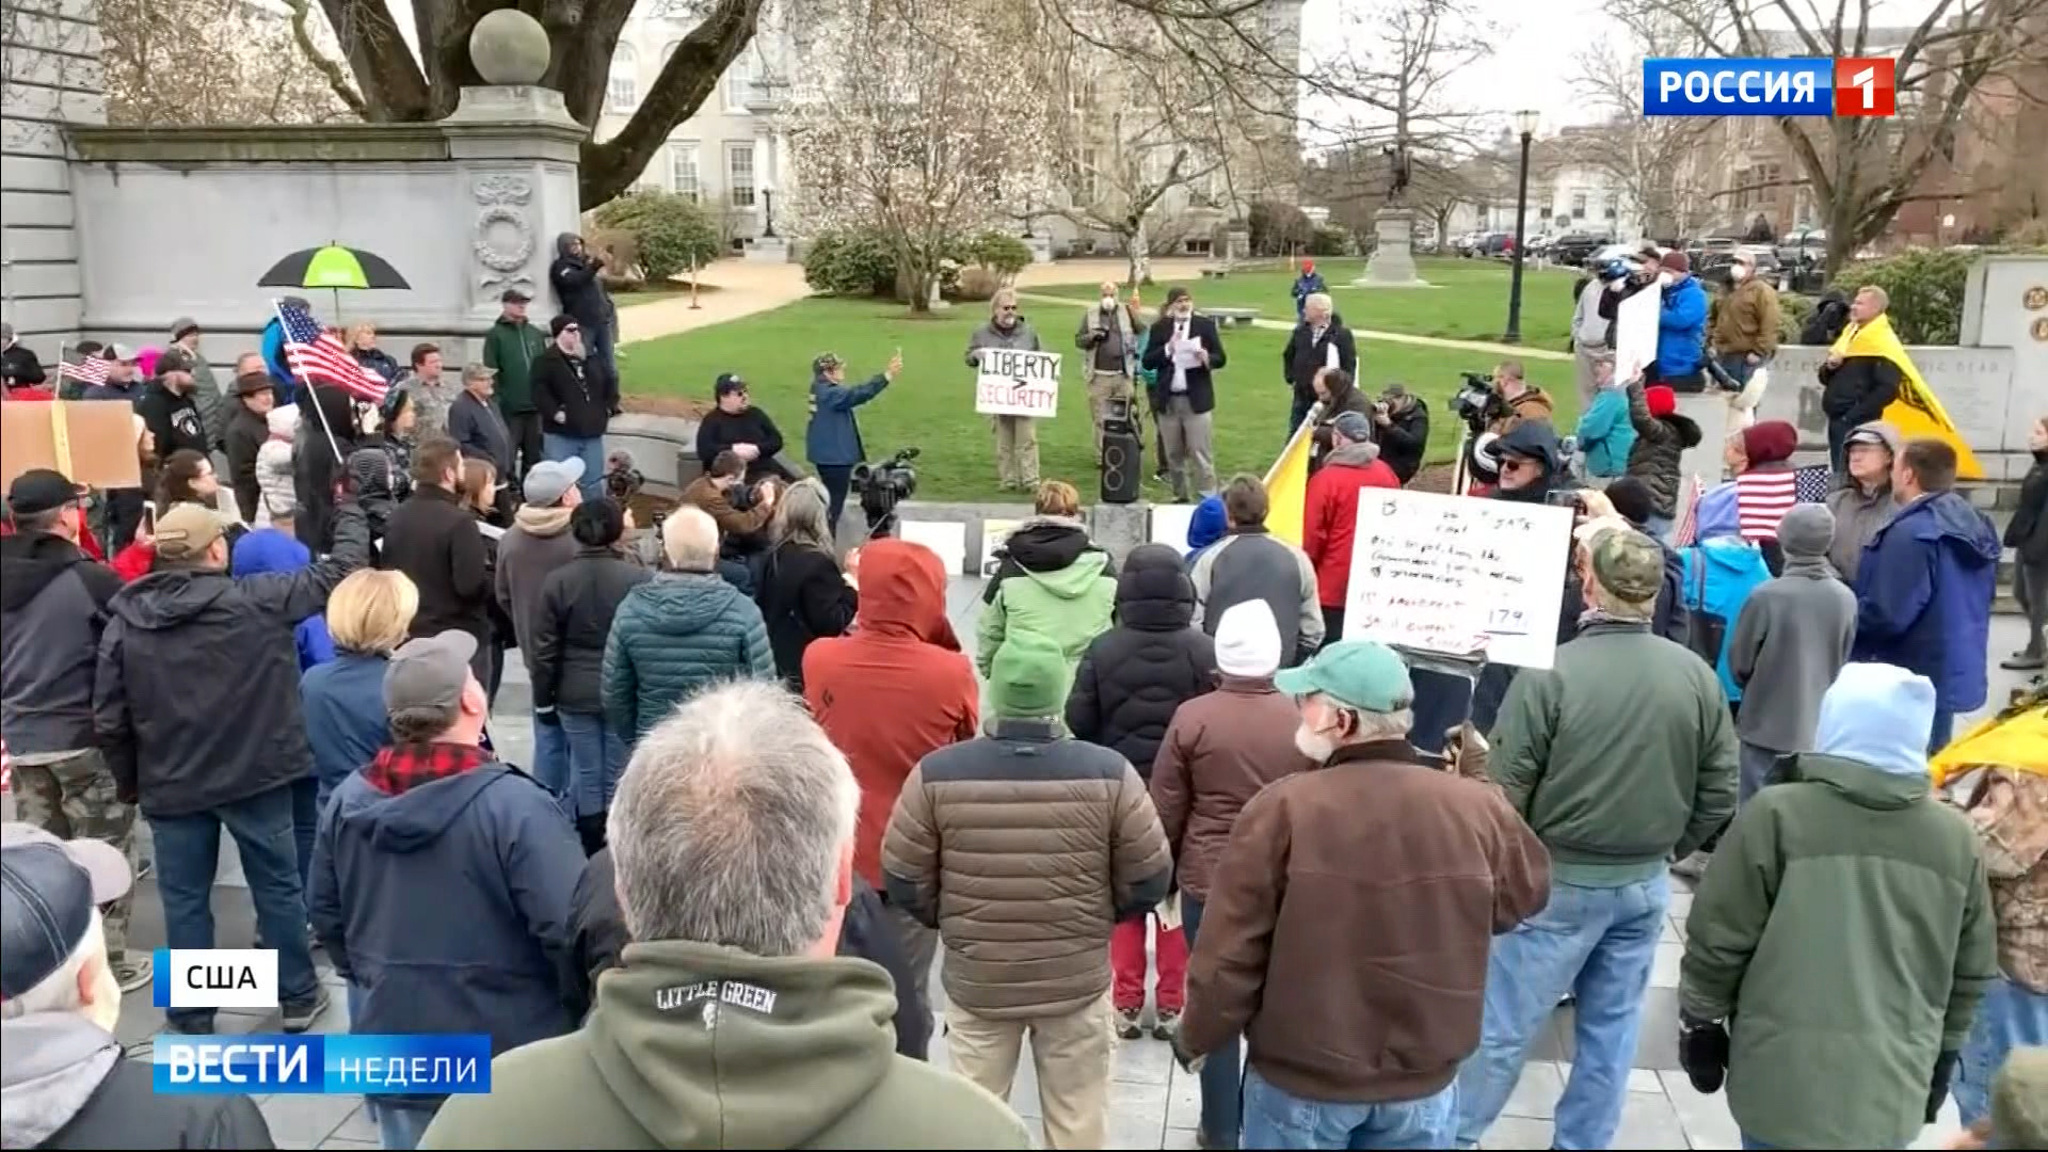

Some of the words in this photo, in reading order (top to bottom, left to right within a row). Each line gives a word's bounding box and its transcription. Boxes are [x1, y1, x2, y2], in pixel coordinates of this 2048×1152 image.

[981, 351, 1060, 379] LIBERTY
[979, 383, 1055, 409] SECURITY
[656, 980, 719, 1010] LITTLE
[720, 980, 777, 1014] GREEN
